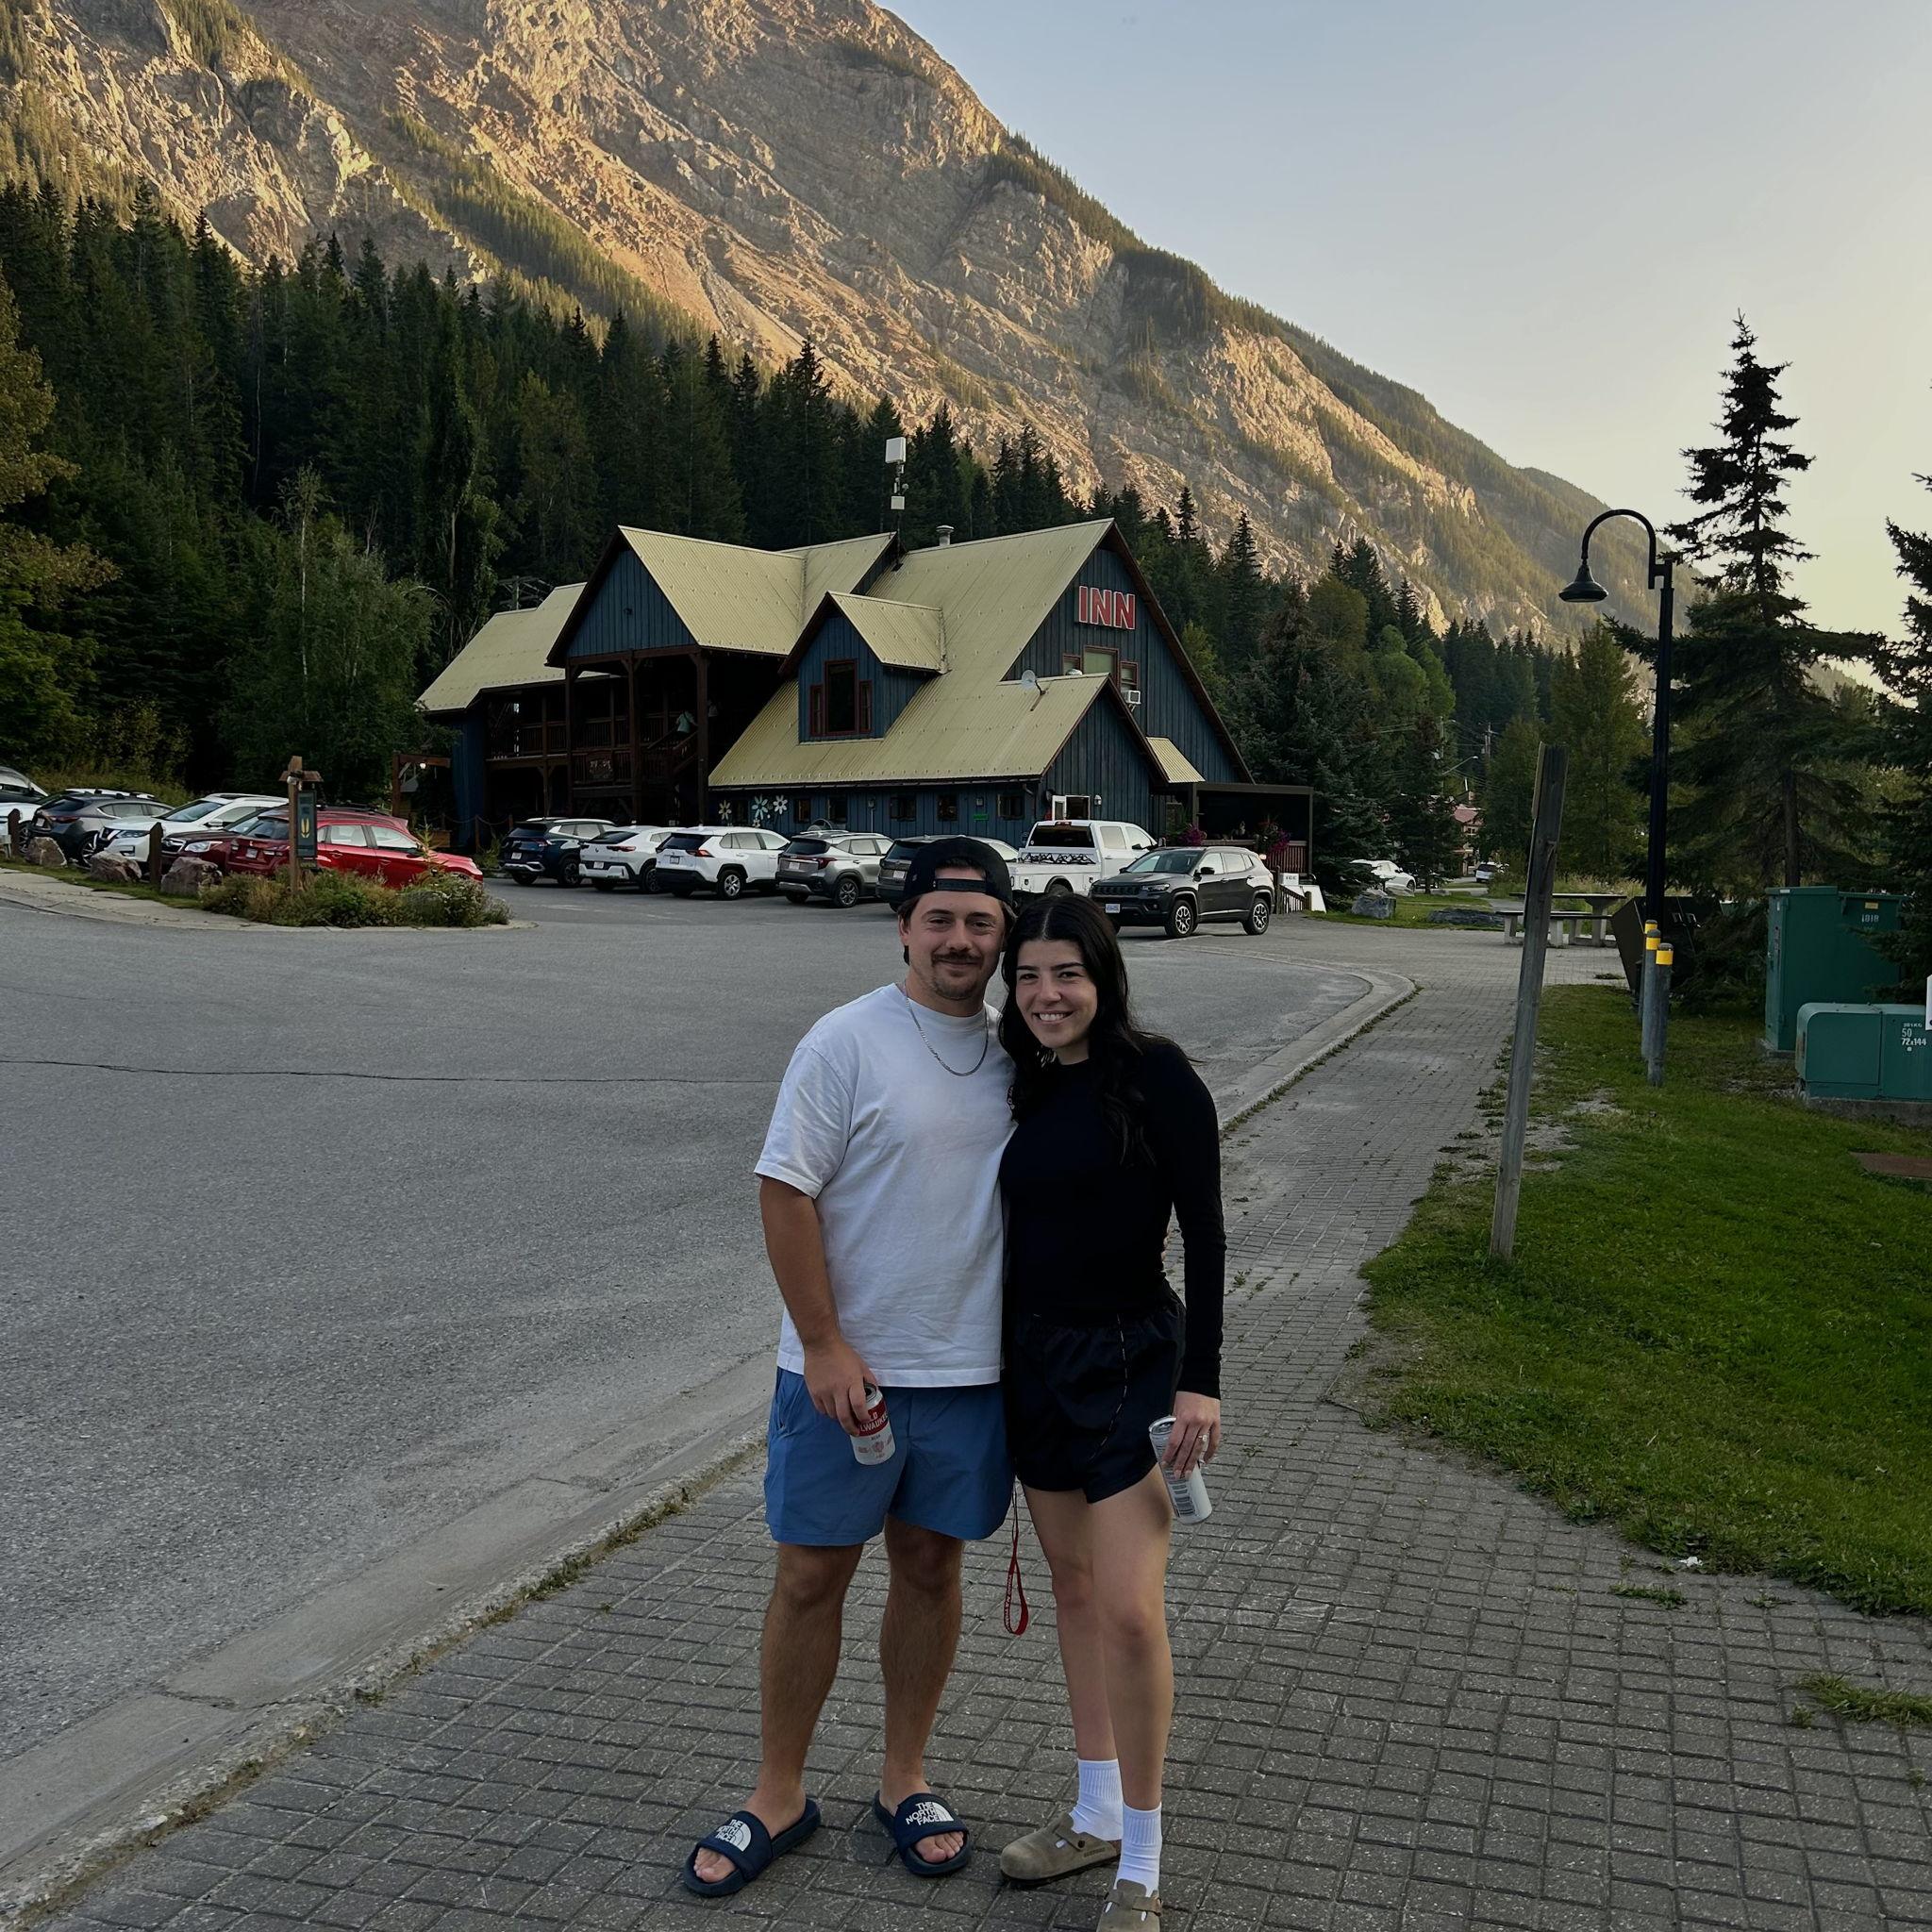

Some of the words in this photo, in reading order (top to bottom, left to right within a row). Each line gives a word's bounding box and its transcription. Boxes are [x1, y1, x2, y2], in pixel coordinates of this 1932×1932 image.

[1078, 585, 1136, 630] INN
[915, 1802, 934, 1810] THE
[905, 1807, 937, 1825] NORTH
[916, 1814, 940, 1825] FACE
